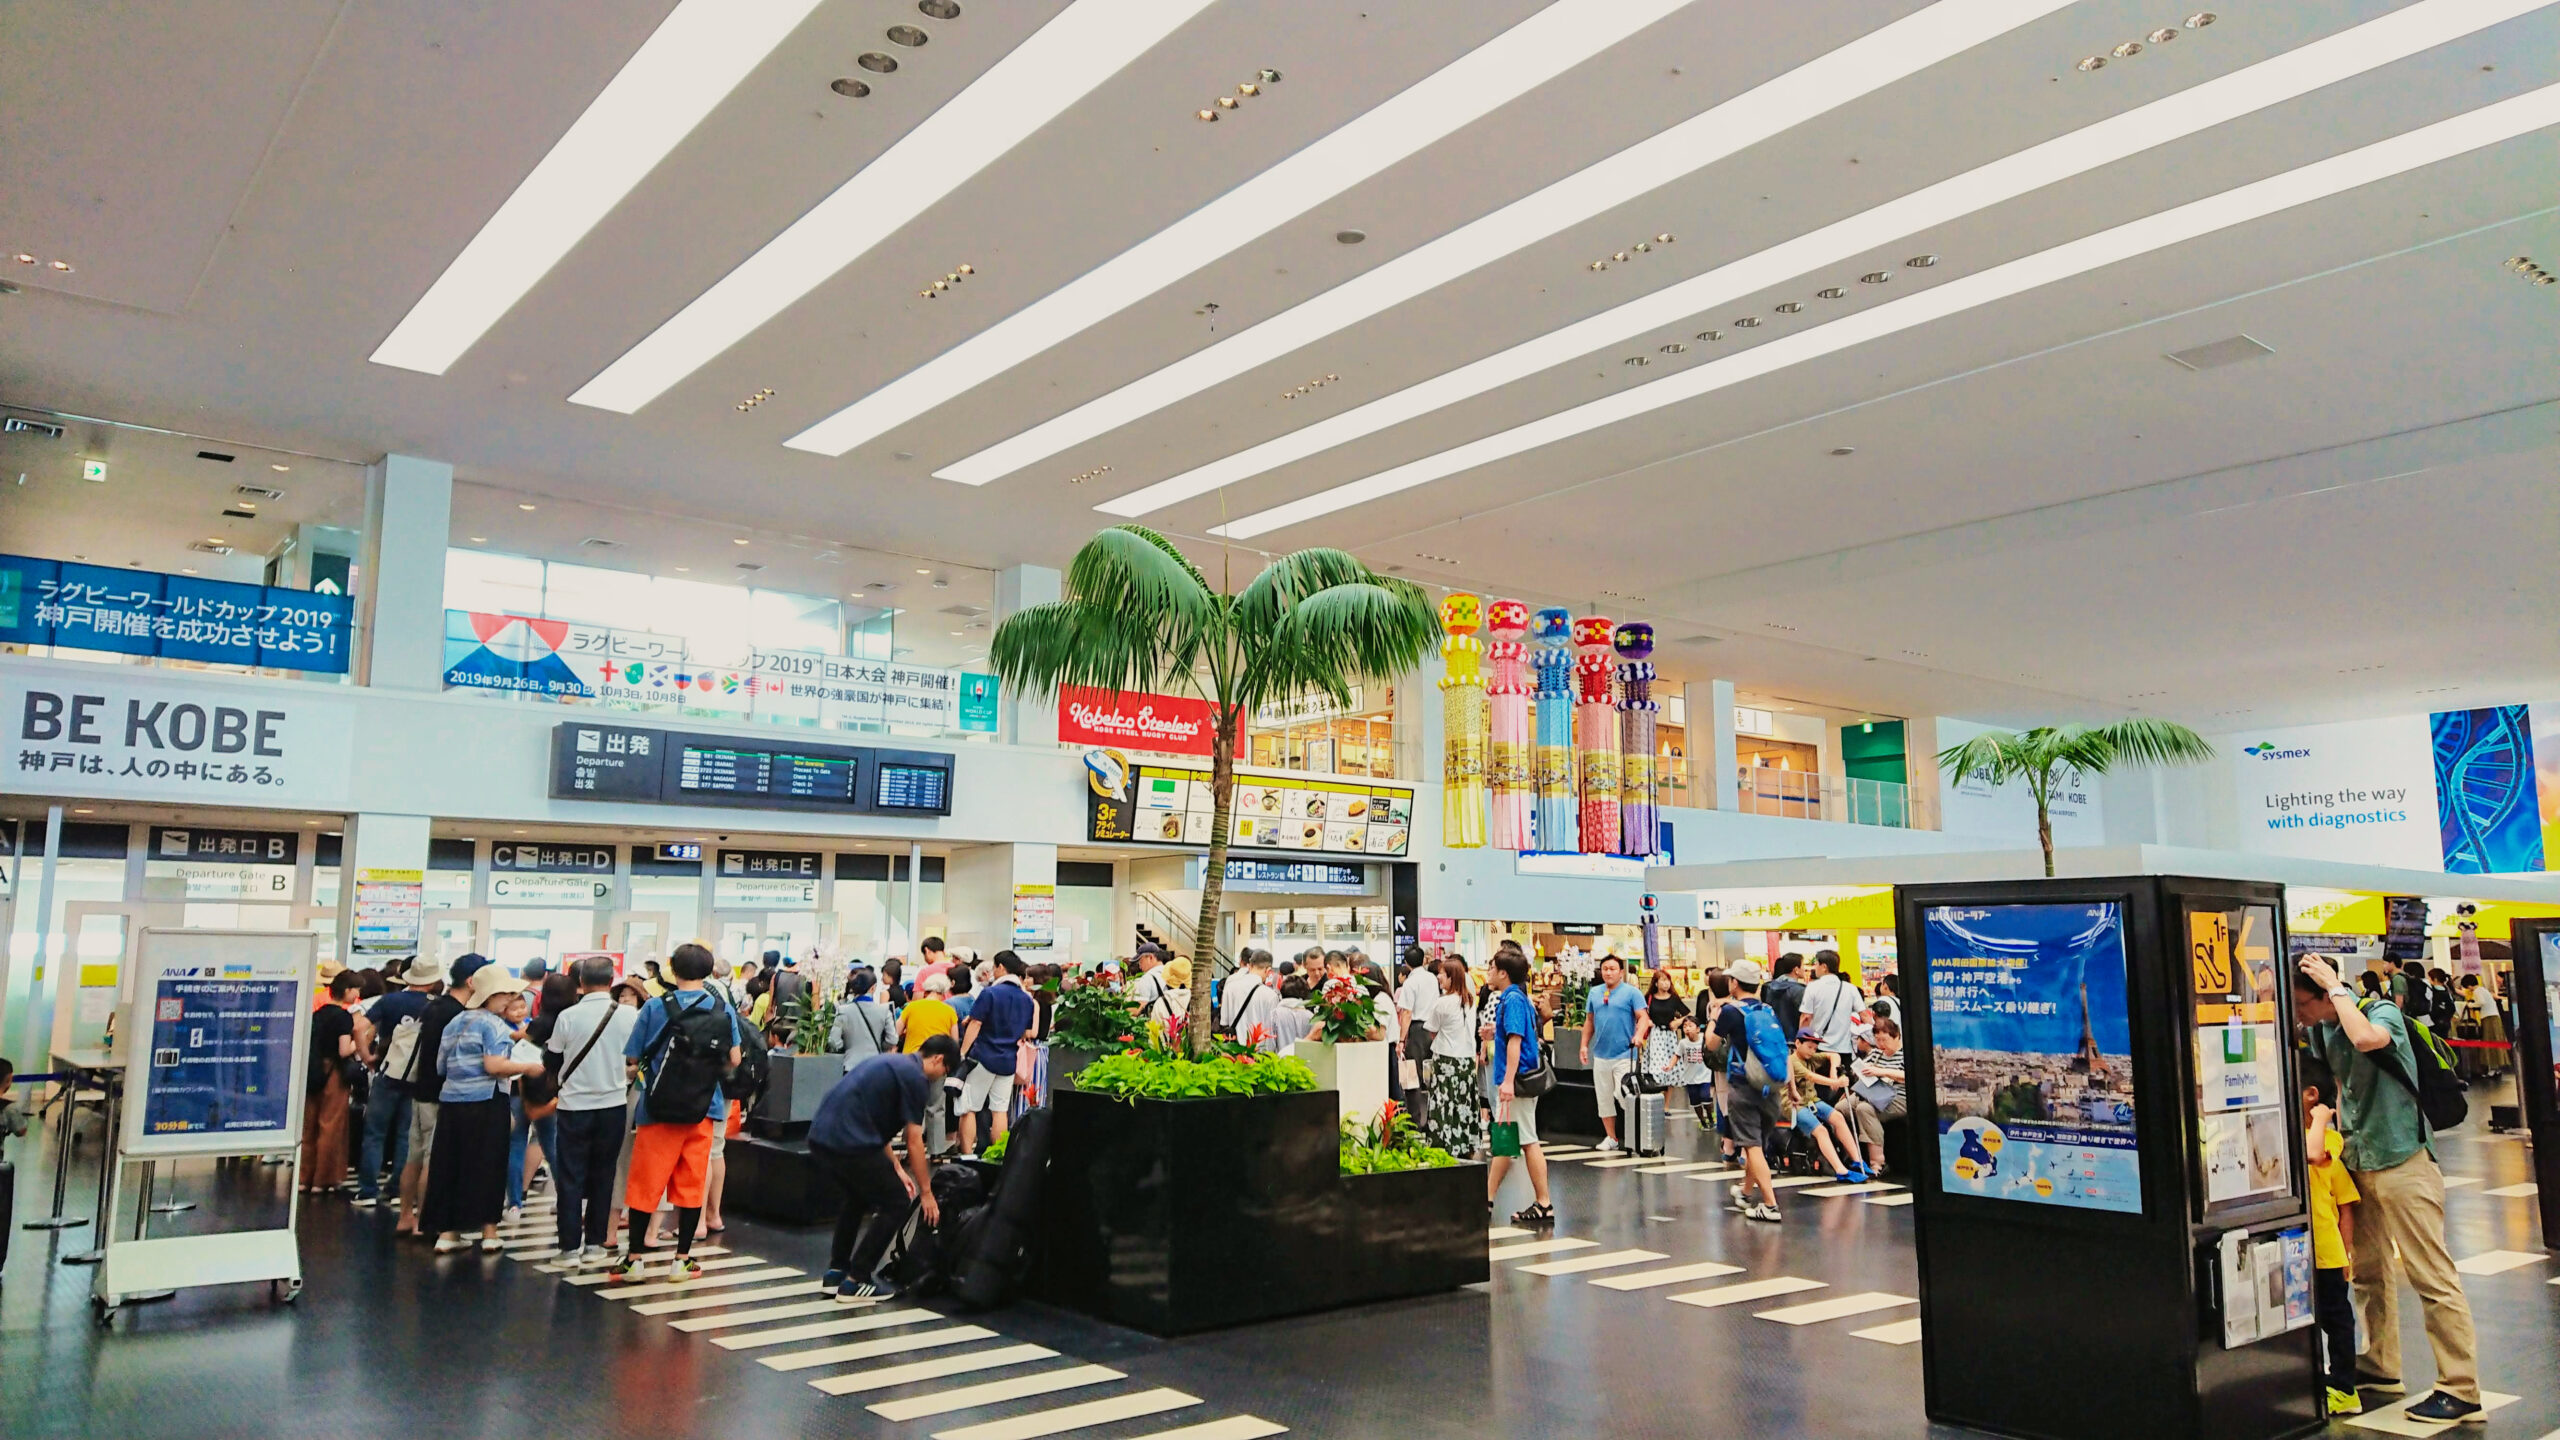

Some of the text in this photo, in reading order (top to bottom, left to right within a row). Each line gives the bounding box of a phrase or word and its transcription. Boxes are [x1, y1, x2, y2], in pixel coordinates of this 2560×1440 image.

[38, 580, 277, 623] ラグビーワールドカップ
[34, 602, 337, 655] 神戸開催を成功させよう!
[825, 662, 886, 683] 日本大会
[891, 669, 956, 690] 神戸開催!
[22, 691, 286, 757] BE KOBE
[1070, 702, 1135, 729] Kobelco
[1094, 726, 1114, 734] KOBE
[1116, 728, 1138, 737] STEEL
[1142, 731, 1166, 739] RUGBY
[606, 734, 650, 755] 出発
[2262, 747, 2310, 760] sysmex
[19, 750, 286, 786] 神戸は、人の中にある。
[576, 756, 625, 767] Departure
[2069, 793, 2087, 804] KOBE
[2266, 788, 2406, 810] Lighting the way
[1097, 803, 1117, 820] 3F
[2267, 809, 2407, 830] with diagnostics
[1096, 821, 1116, 829] フライト
[199, 838, 285, 860] 出発口 B
[494, 847, 610, 869] C 出発口 D
[176, 868, 266, 880] Departure Gate
[751, 858, 813, 875] 出発口 E
[1227, 861, 1242, 878] 3F
[1287, 864, 1302, 880] 4F
[272, 875, 286, 891] B
[495, 880, 509, 895] C
[594, 883, 607, 897] D
[736, 882, 778, 892] Departure
[803, 887, 814, 901] E
[2214, 917, 2226, 942] 1F
[161, 967, 187, 977] ANA
[2225, 1074, 2257, 1088] FamilyMart
